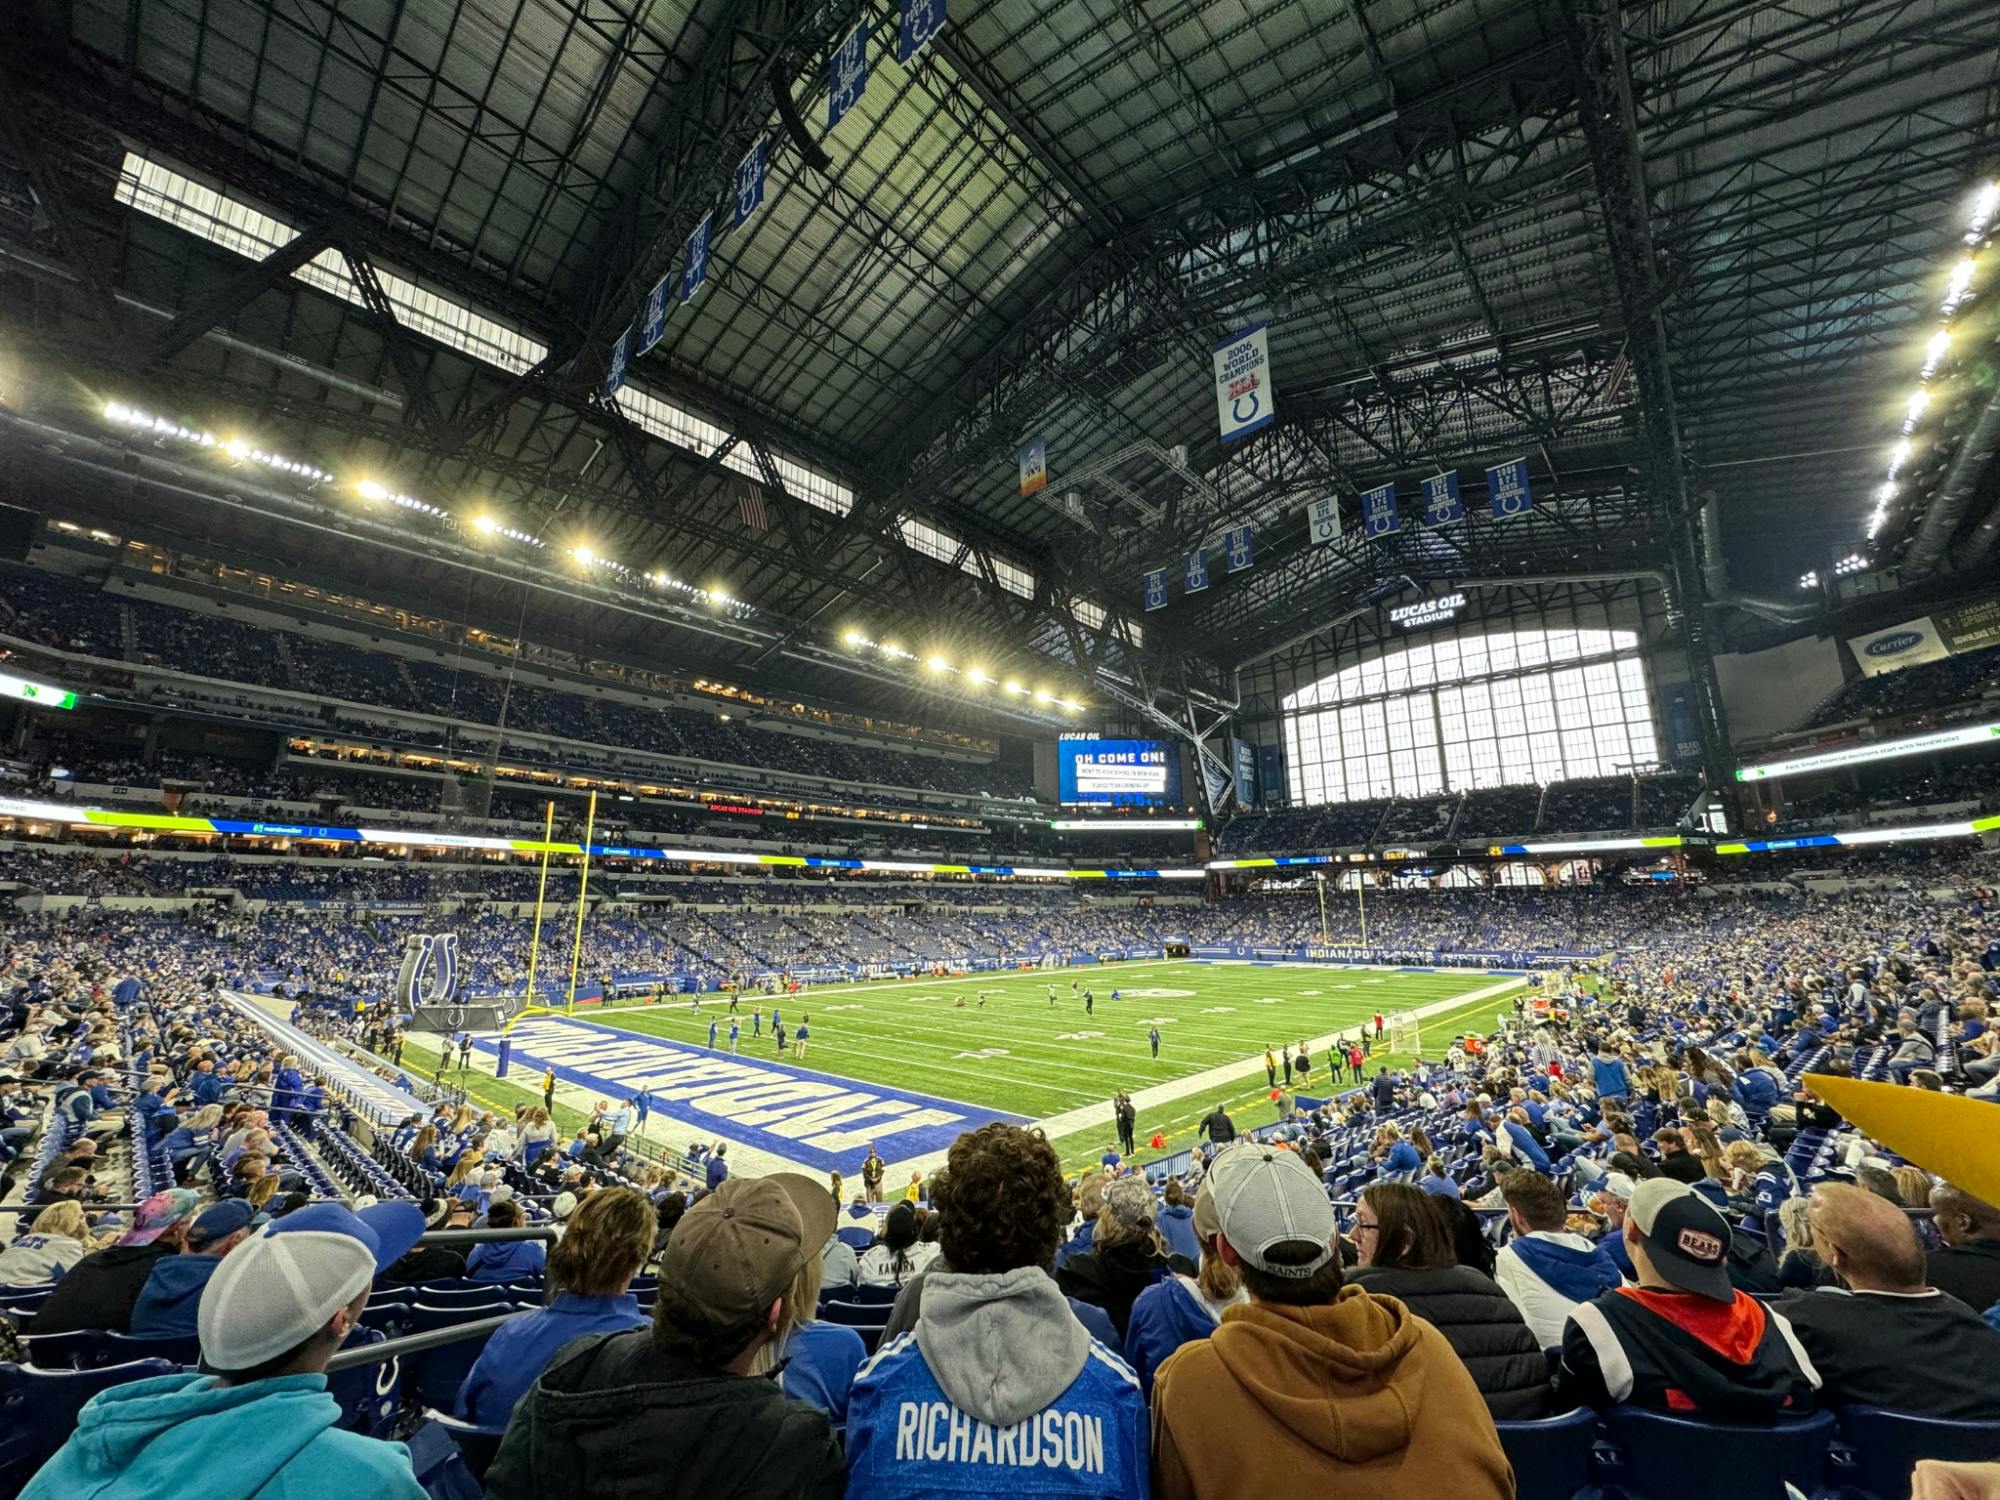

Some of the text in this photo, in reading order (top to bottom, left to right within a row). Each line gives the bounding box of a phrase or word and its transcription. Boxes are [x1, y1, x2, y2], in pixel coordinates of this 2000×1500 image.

[1223, 348, 1259, 372] WORLD
[1227, 341, 1253, 360] 2006
[1219, 355, 1264, 384] CHAMPIONS
[1390, 593, 1466, 621] LUCAS OIL
[1403, 609, 1454, 627] STADIUM
[1872, 634, 1915, 654] Carrier
[1059, 732, 1100, 741] LUCAS OIL
[1075, 752, 1165, 764] OH COME ON!
[320, 901, 347, 909] TEXT
[1682, 1233, 1719, 1256] BEARS
[878, 1259, 916, 1276] KAMRA
[895, 1401, 1104, 1475] RICHARDSON
